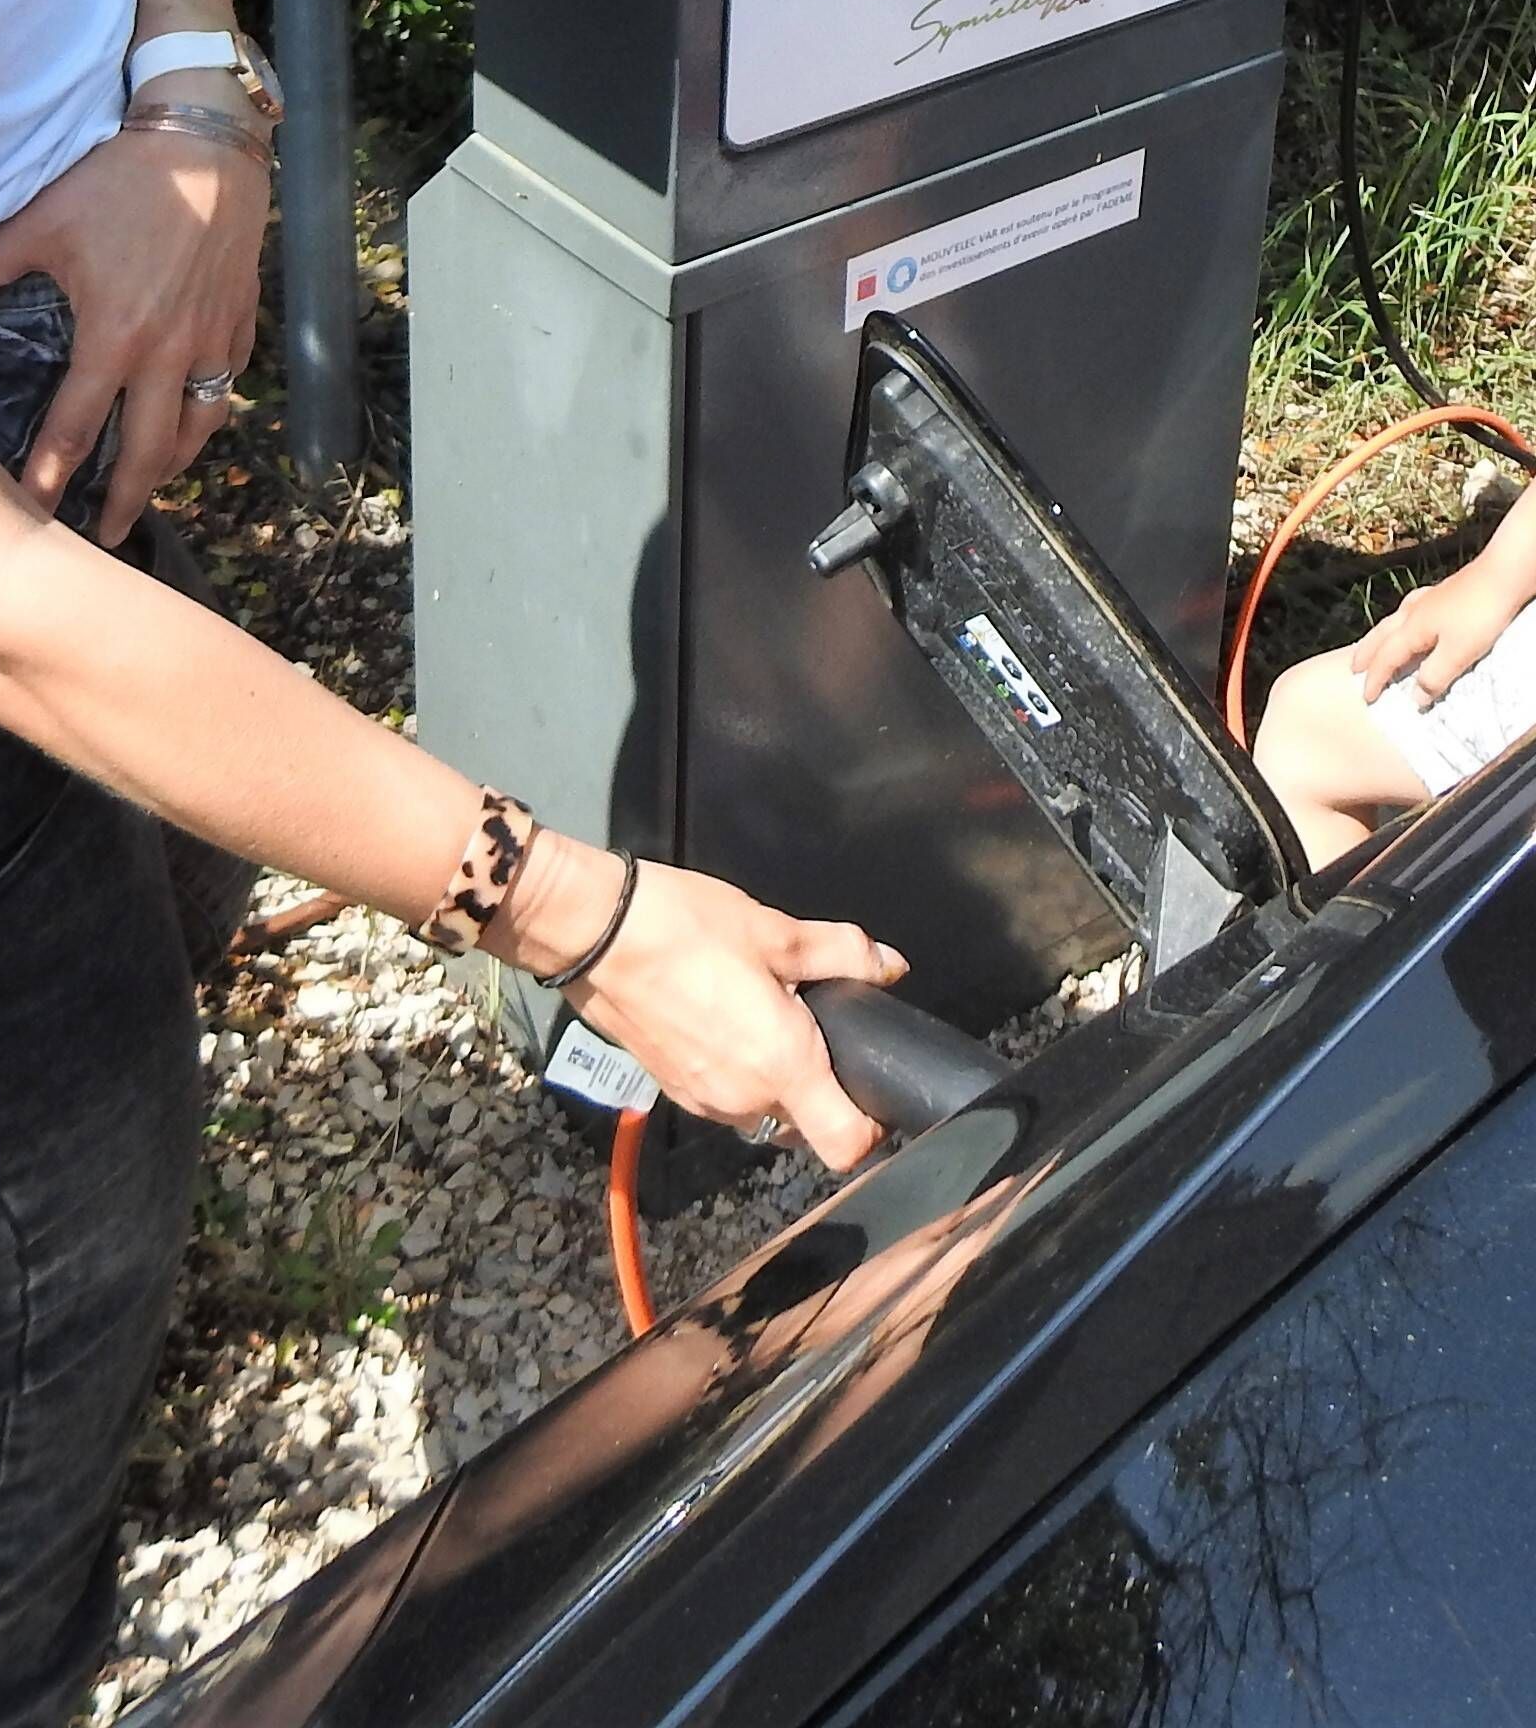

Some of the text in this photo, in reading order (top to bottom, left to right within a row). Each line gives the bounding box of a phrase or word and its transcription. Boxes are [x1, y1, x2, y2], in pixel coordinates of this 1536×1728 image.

[919, 177, 1134, 267] MOUV'ELEC VAR est soutenu par le Programme
[919, 268, 938, 283] des
[937, 239, 1012, 273] investissements
[1013, 224, 1050, 244] d'avenir
[1079, 208, 1095, 223] par
[1096, 191, 1134, 214] l'ADEME
